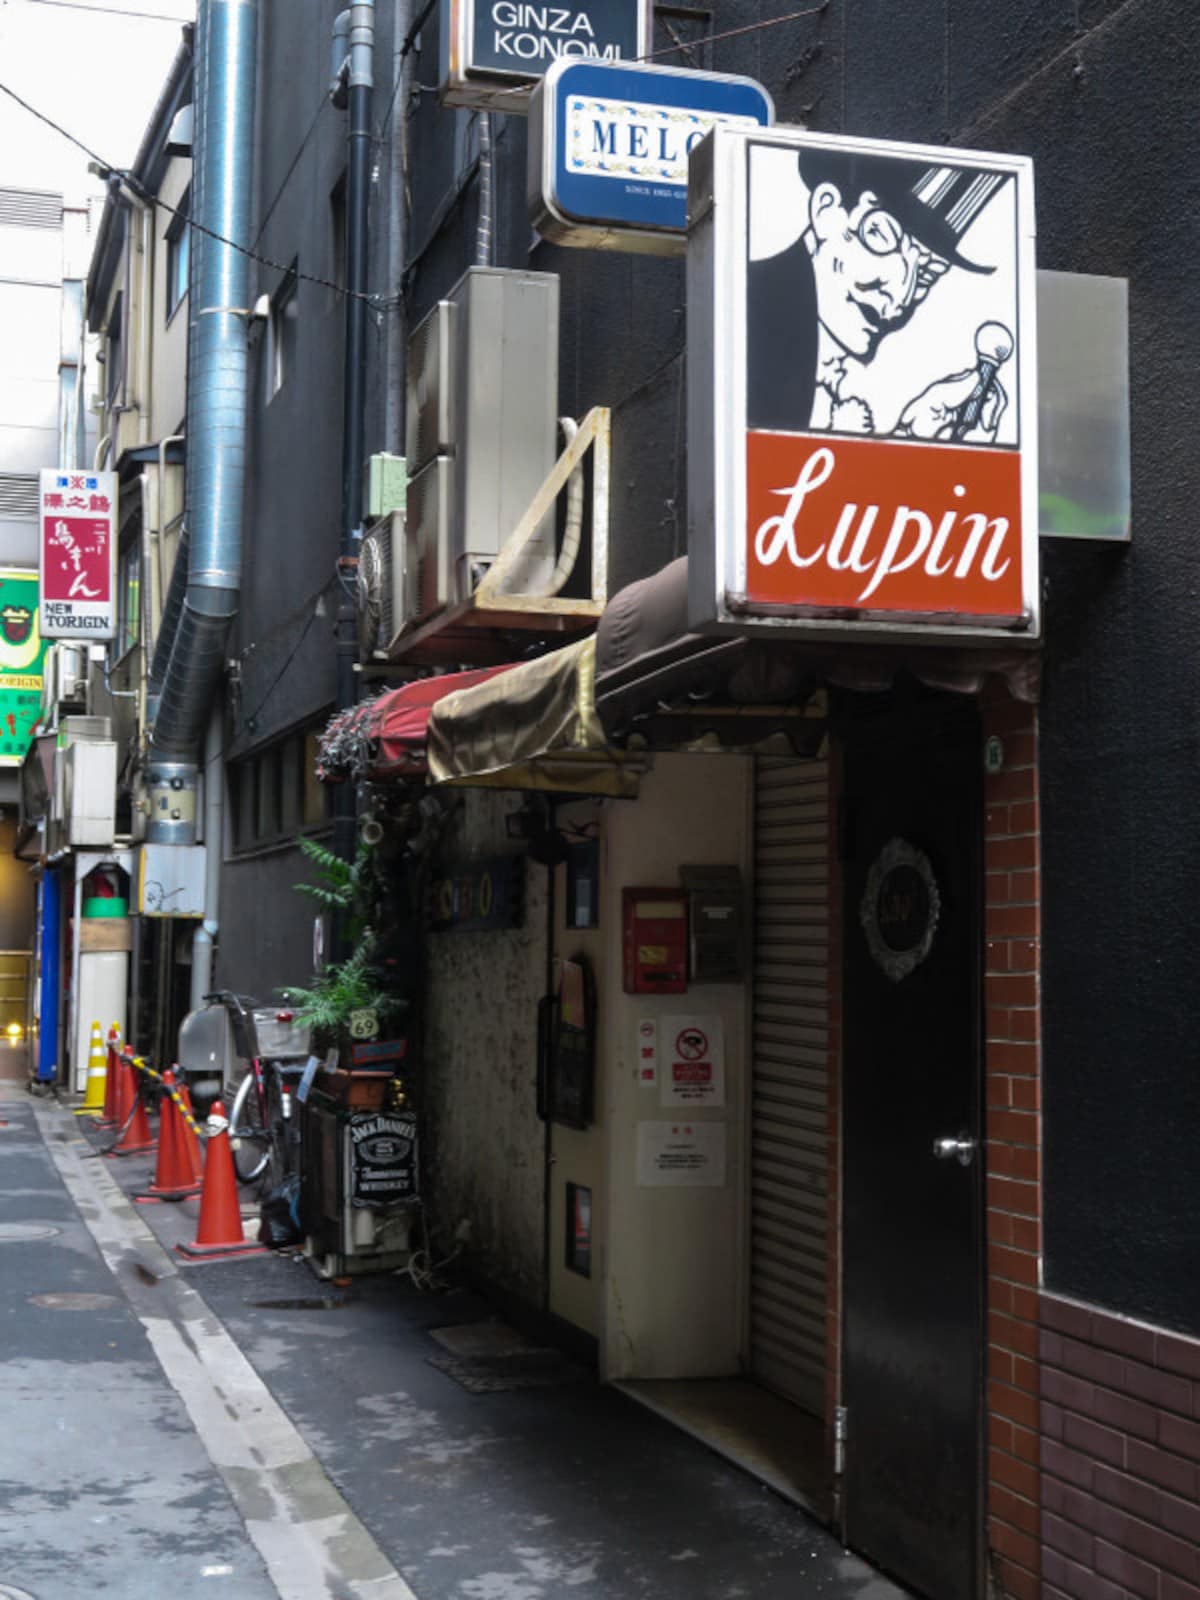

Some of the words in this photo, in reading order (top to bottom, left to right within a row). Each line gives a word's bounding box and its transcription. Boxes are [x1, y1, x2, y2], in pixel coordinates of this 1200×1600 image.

[492, 2, 595, 37] GINZA
[494, 31, 621, 60] KONOMI
[755, 447, 1011, 603] Lupin
[45, 603, 72, 614] NEW
[45, 615, 109, 628] TORIGIN
[355, 1019, 374, 1035] 69
